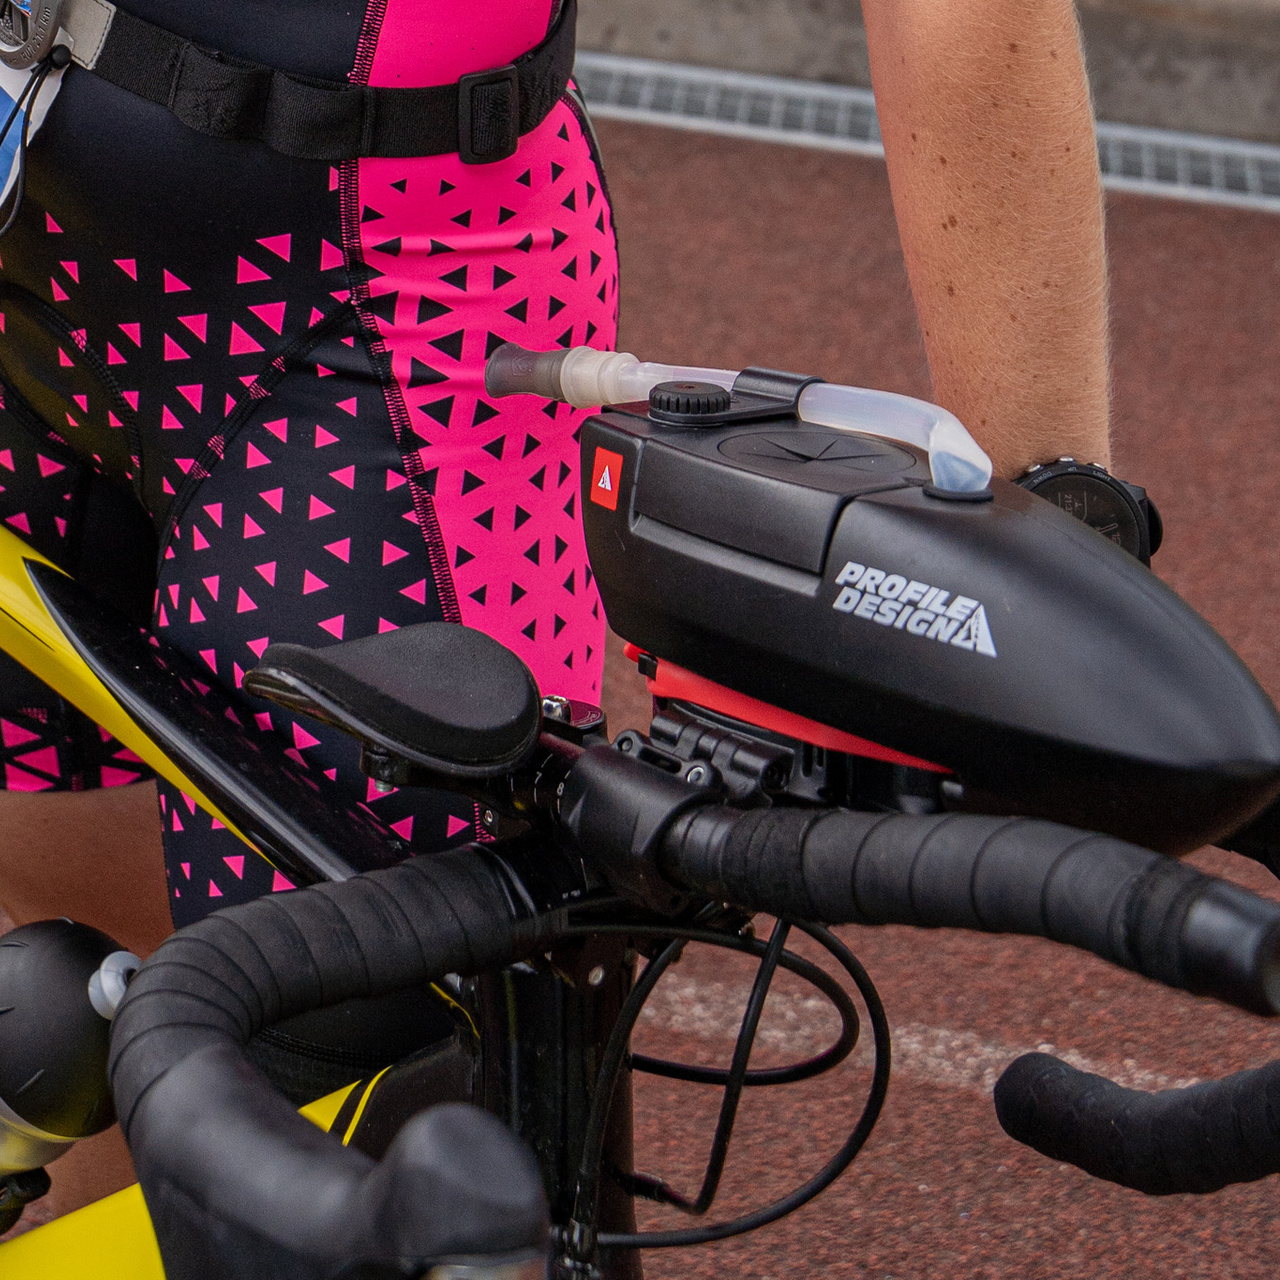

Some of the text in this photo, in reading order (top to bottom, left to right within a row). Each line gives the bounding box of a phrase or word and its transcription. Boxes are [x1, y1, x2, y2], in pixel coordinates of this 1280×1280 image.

[1092, 470, 1111, 482] LIGHT
[832, 586, 962, 644] DESIGN
[835, 560, 980, 623] PROFILE
